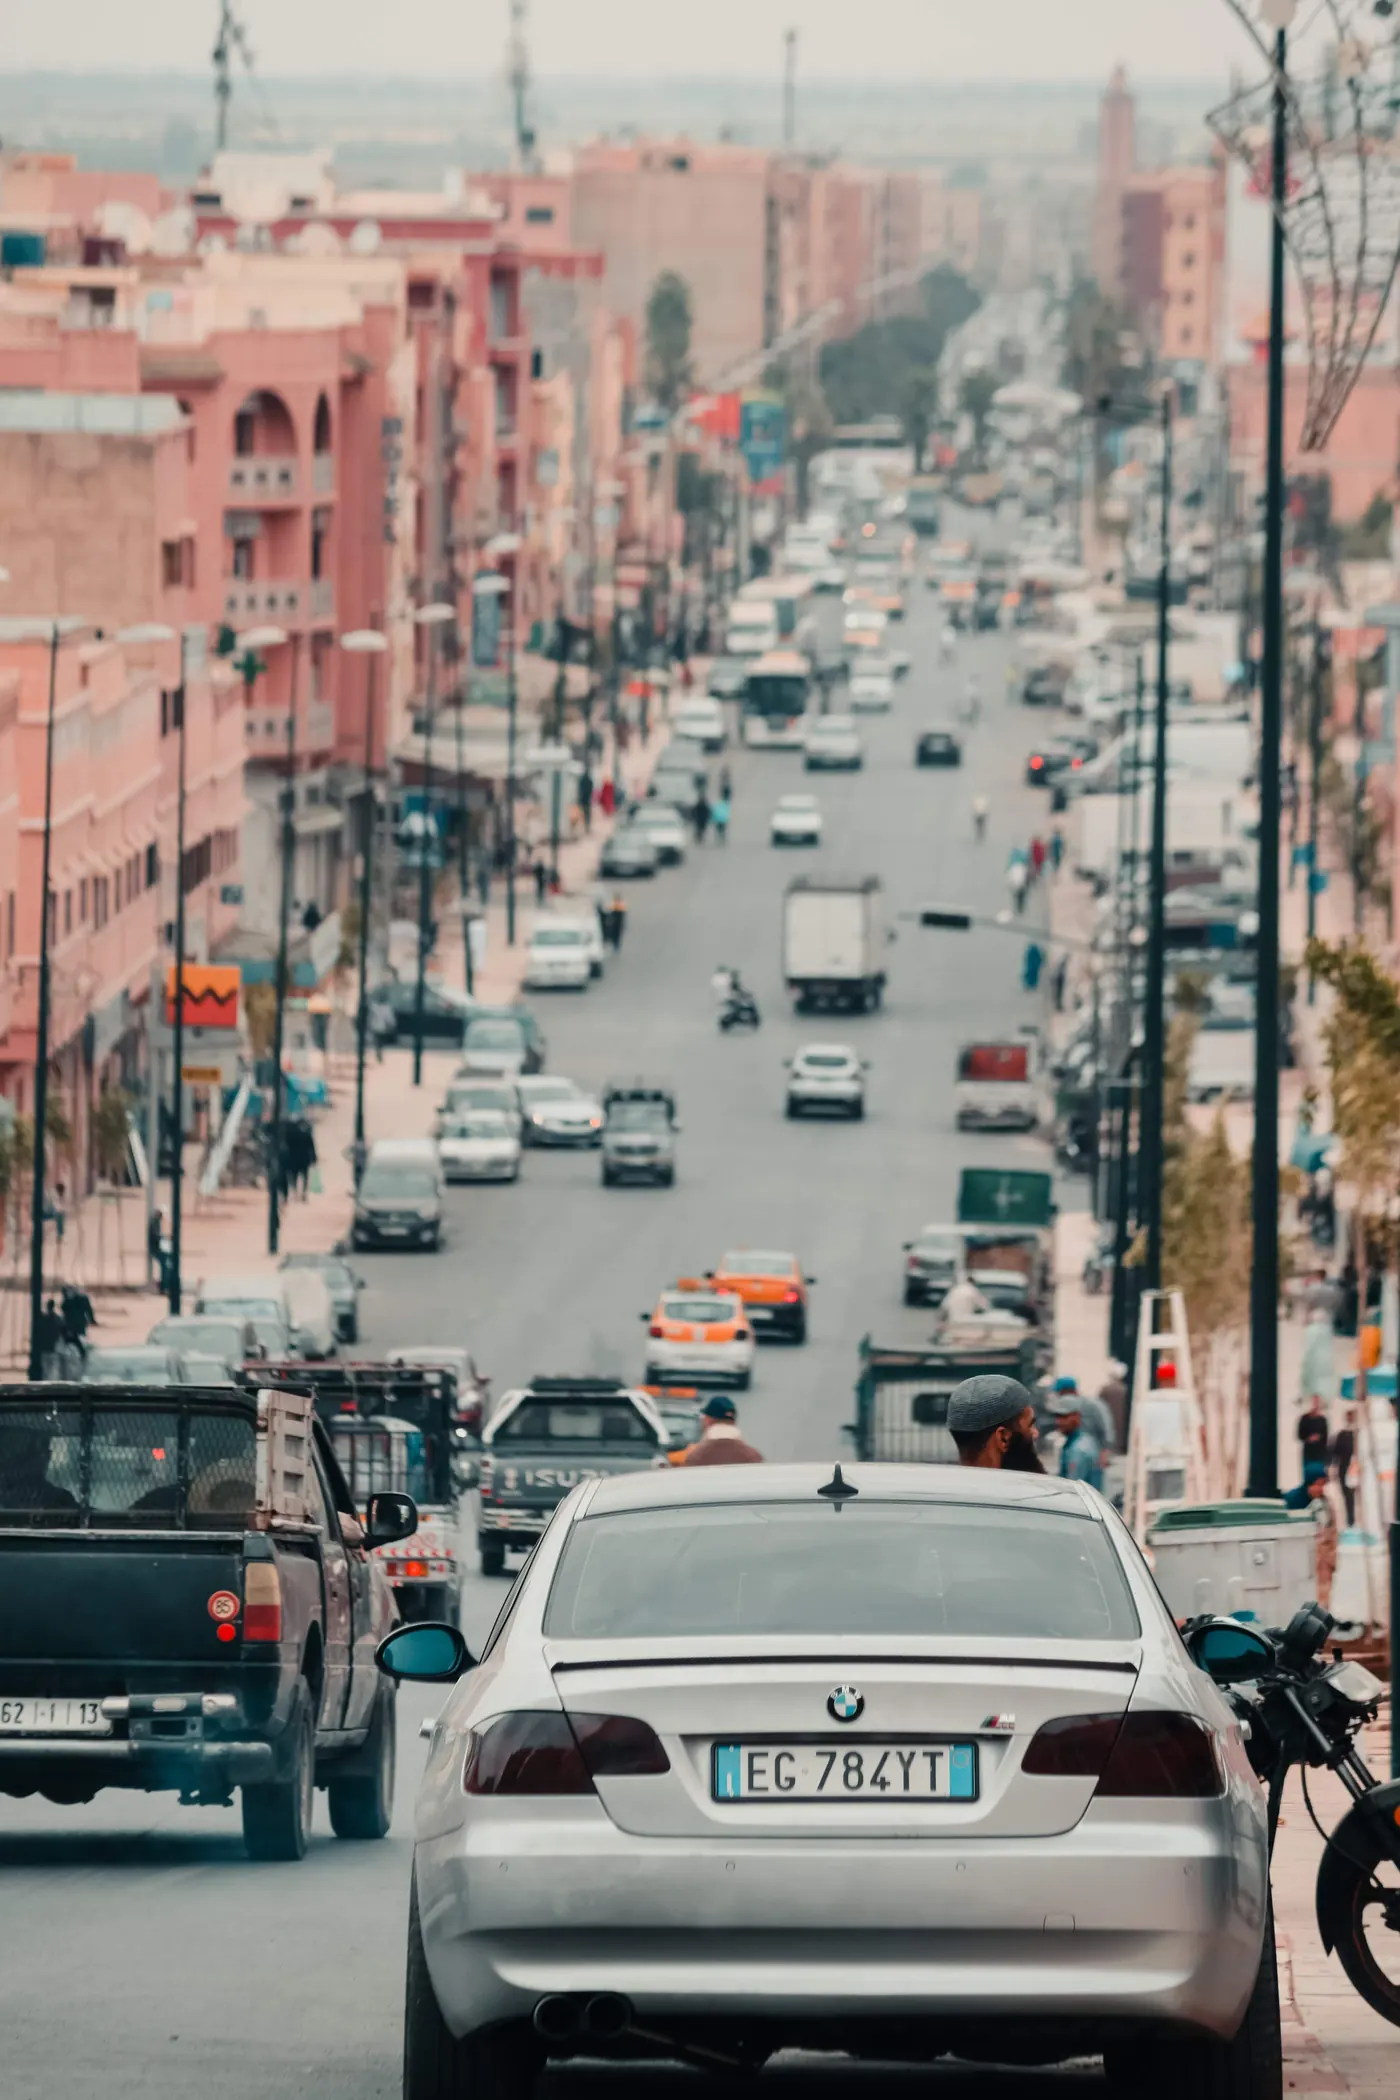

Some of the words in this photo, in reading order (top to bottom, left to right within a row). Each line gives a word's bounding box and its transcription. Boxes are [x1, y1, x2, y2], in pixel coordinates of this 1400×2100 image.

[215, 1599, 231, 1614] 85
[1, 1702, 24, 1724] 62
[79, 1702, 99, 1725] 13
[747, 1751, 796, 1792] EG
[815, 1751, 944, 1792] 784YT
